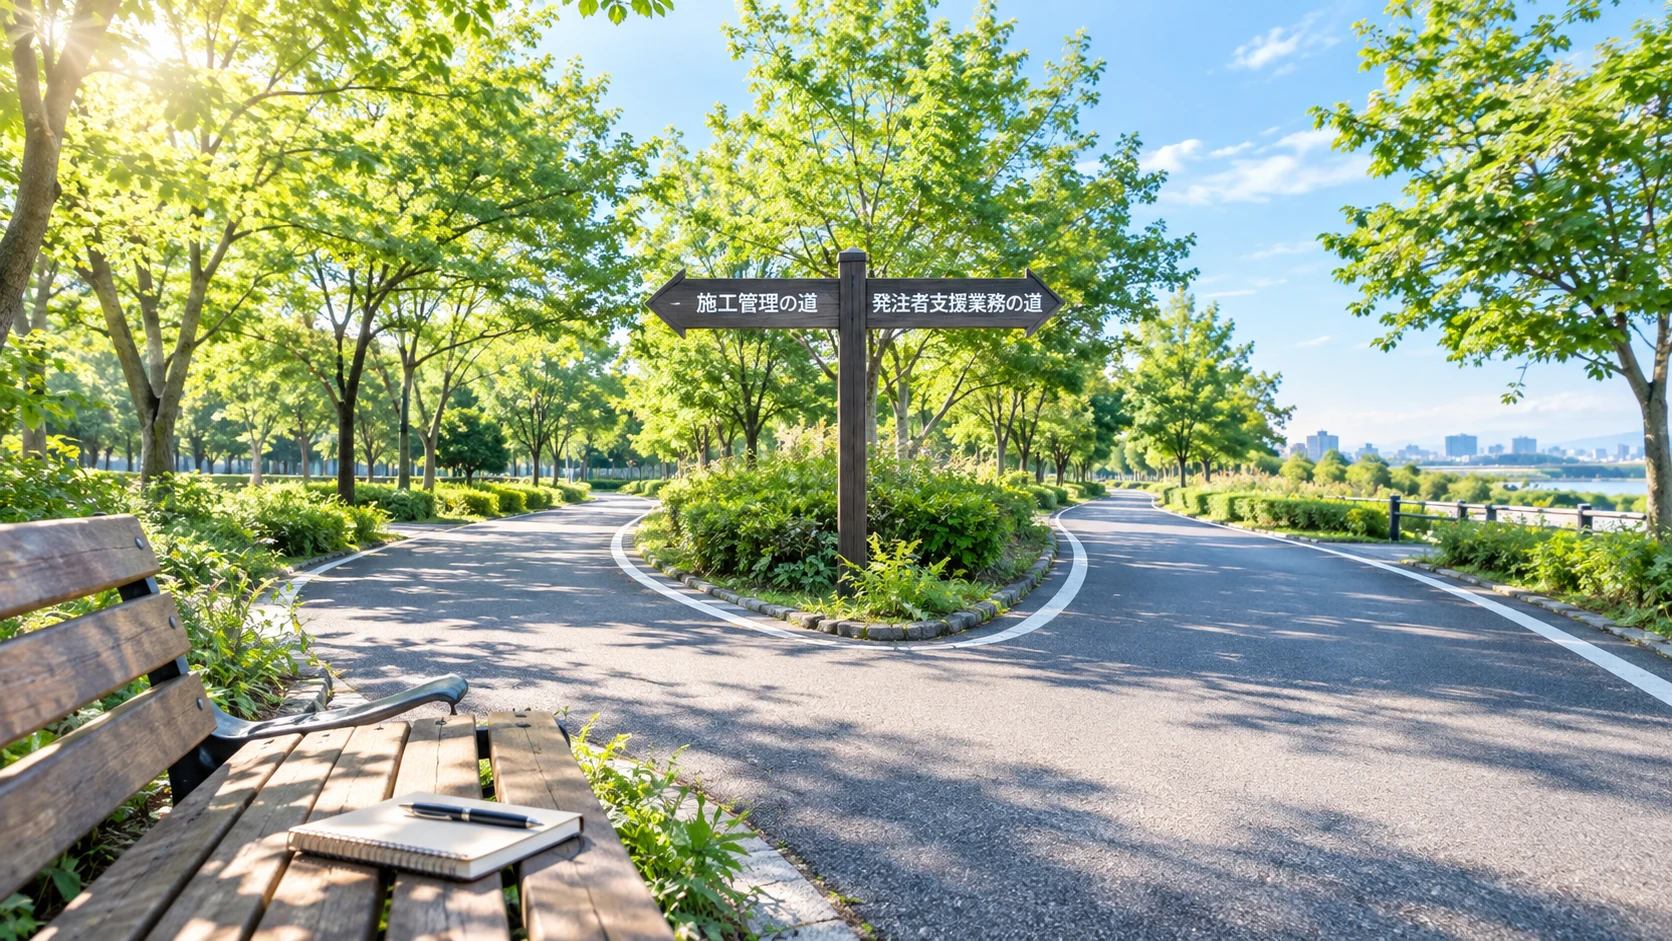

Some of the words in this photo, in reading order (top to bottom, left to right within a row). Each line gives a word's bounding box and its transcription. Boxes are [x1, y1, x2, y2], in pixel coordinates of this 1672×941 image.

[696, 292, 818, 313] 施工管理の道
[872, 292, 1043, 313] 発注者支援業務の道
